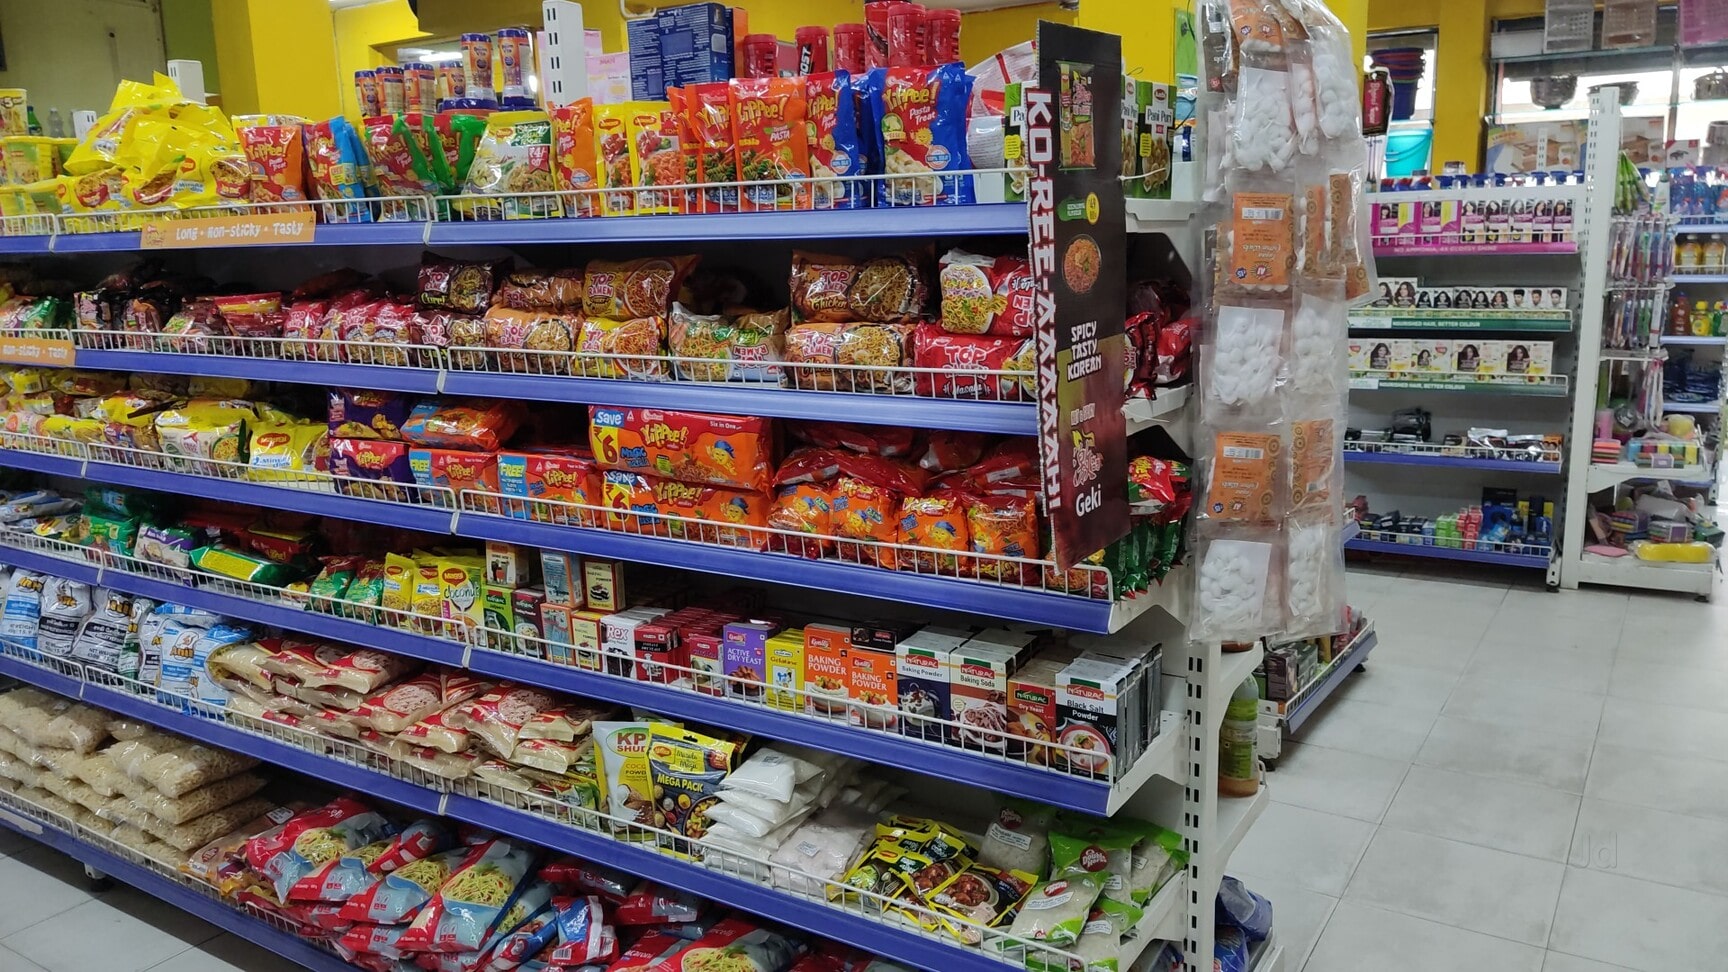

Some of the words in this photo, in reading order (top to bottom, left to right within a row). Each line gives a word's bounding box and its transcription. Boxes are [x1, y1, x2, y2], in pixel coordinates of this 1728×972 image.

[909, 106, 931, 120] Pasta
[915, 112, 936, 126] Treat
[1147, 110, 1159, 121] Pani
[1160, 112, 1173, 123] Puri
[770, 130, 791, 142] PASTA
[176, 226, 198, 242] Long
[273, 220, 304, 236] Tasty
[591, 273, 614, 287] TOP
[821, 269, 850, 283] TOP
[588, 284, 613, 297] RAMEN
[821, 281, 848, 293] AMEN
[810, 296, 847, 311] Chicken
[1071, 322, 1097, 343] SPICY
[733, 344, 768, 355] RAMEN
[803, 344, 833, 357] RAMEN
[944, 346, 989, 366] TOP
[1071, 339, 1098, 361] TASTY
[942, 363, 990, 379] RAMEN
[1067, 355, 1102, 382] KOREAN
[596, 411, 622, 425] Save
[710, 420, 718, 428] Six
[1076, 487, 1102, 518] Geki
[444, 572, 465, 581] Maggi
[607, 625, 628, 640] Rex
[727, 653, 741, 662] DRY
[741, 655, 762, 666] YEAST
[728, 648, 750, 658] ACTIVE
[808, 654, 841, 666] BAKING
[906, 656, 938, 669] NATURAL
[808, 662, 847, 675] POWDER
[902, 665, 920, 675] Baking
[921, 668, 943, 678] Powder
[961, 666, 994, 679] NATURAL
[852, 671, 882, 683] BAKING
[960, 675, 980, 686] Baking
[980, 678, 995, 688] Soda
[851, 679, 887, 691] POWDER
[1017, 692, 1047, 704] NATURAL
[1067, 687, 1104, 701] NATURAL
[1029, 705, 1045, 714] Yeast
[1067, 700, 1087, 710] Black
[1088, 704, 1104, 714] Salt
[1072, 710, 1099, 722] Powder
[657, 773, 681, 787] MEGA
[681, 779, 704, 793] PACK
